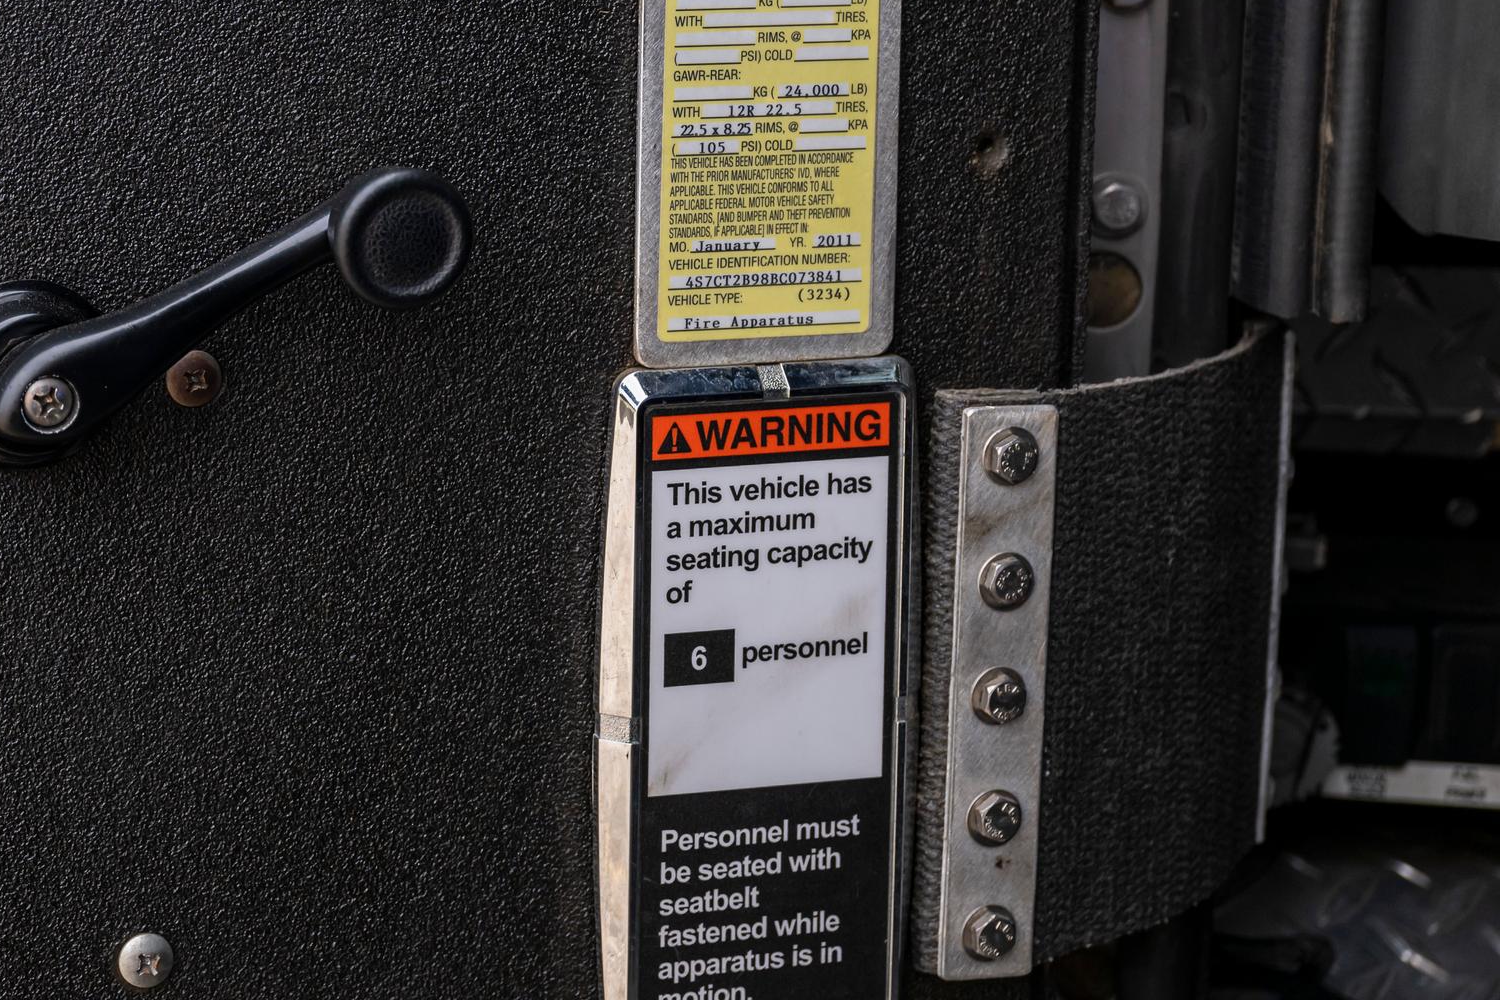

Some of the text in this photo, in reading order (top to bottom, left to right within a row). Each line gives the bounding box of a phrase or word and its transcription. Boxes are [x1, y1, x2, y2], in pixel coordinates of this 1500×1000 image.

[674, 70, 741, 82] GAWR-REAR:
[753, 87, 768, 97] KG
[673, 107, 700, 118] WITH
[729, 105, 755, 117] 12R
[766, 104, 801, 116] 22.5
[680, 124, 707, 136] 22.5
[724, 123, 751, 135] 8.25
[848, 119, 868, 130] KPA
[699, 140, 793, 153] 105 PSI) COLD
[671, 153, 853, 168] THIS VEHICLE HAS BEEN COMPLETED IN ACCORDANCE
[669, 235, 852, 253] MO. January YR. 2011
[669, 253, 850, 270] VEHICLE IDENTIFICATION NUMBER:
[668, 287, 850, 306] VEHICLE TYPE: (3234)
[685, 314, 813, 329] Fire Apparatus
[696, 409, 881, 451] WARNING
[667, 471, 872, 506] This vehicle has
[667, 511, 815, 538] a maximum
[666, 536, 873, 572] seating capacity
[666, 580, 692, 604] of
[691, 632, 868, 671] 6 personnel
[661, 814, 860, 852] Personnel must
[660, 847, 841, 884] be seated with
[659, 886, 760, 916] seatbelt
[658, 911, 840, 948] fastened while
[658, 942, 842, 984] apparatus is in
